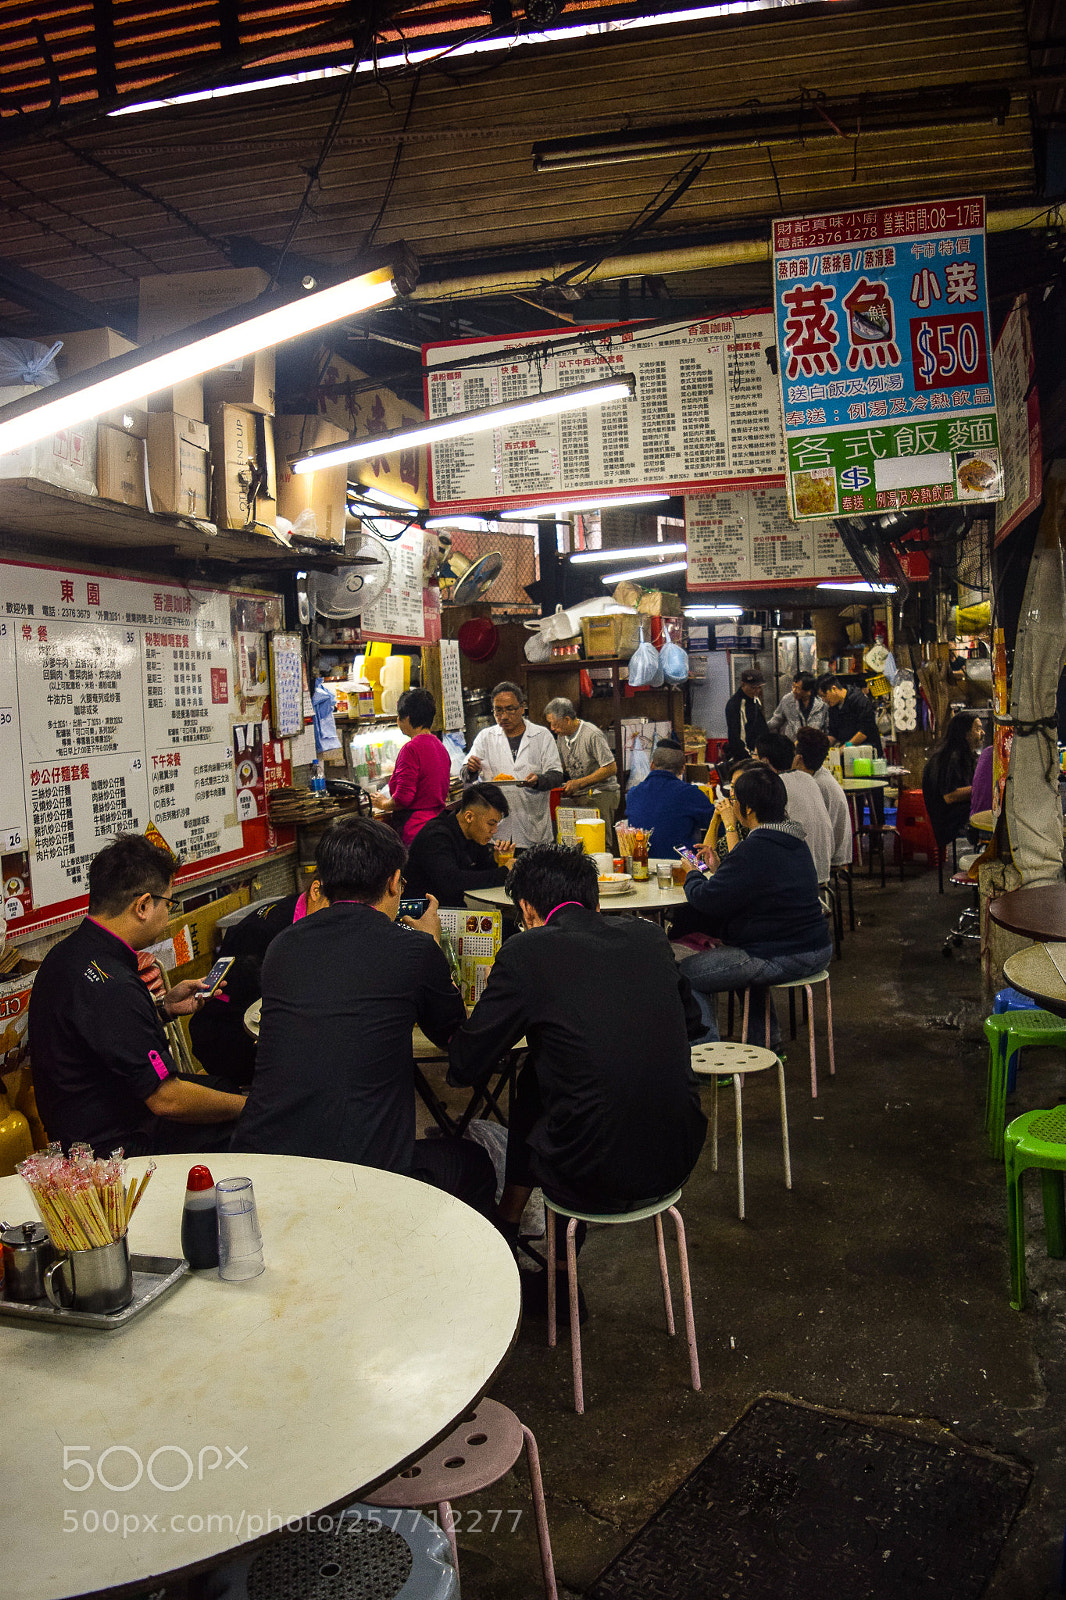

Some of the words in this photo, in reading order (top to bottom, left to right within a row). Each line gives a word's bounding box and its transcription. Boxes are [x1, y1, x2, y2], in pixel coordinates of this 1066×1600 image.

[776, 212, 878, 236] 財記真味小廚
[777, 231, 841, 250] 電話:2376
[845, 226, 878, 242] 1278
[911, 238, 970, 260] 午市特價
[688, 322, 732, 336] 香濃咖啡
[782, 276, 902, 380] 蒸魚
[910, 261, 979, 310] 小菜
[916, 321, 979, 385] $50
[787, 373, 904, 405] 送白飯及例湯
[791, 418, 996, 468] 各式飯麵
[840, 466, 872, 492] $
[153, 593, 192, 614] 香濃咖啡
[126, 632, 134, 643] 35
[47, 694, 73, 705] 牛油方包
[74, 705, 98, 715] 咖啡或茶
[0, 714, 12, 724] 30
[30, 763, 90, 786] 炒公仔麵套餐
[151, 753, 181, 769] 下午茶餐
[133, 759, 141, 770] 43
[10, 833, 21, 846] 26
[35, 832, 74, 849] 牛肉炒公仔麵
[36, 844, 75, 862] 肉片炒公仔麵
